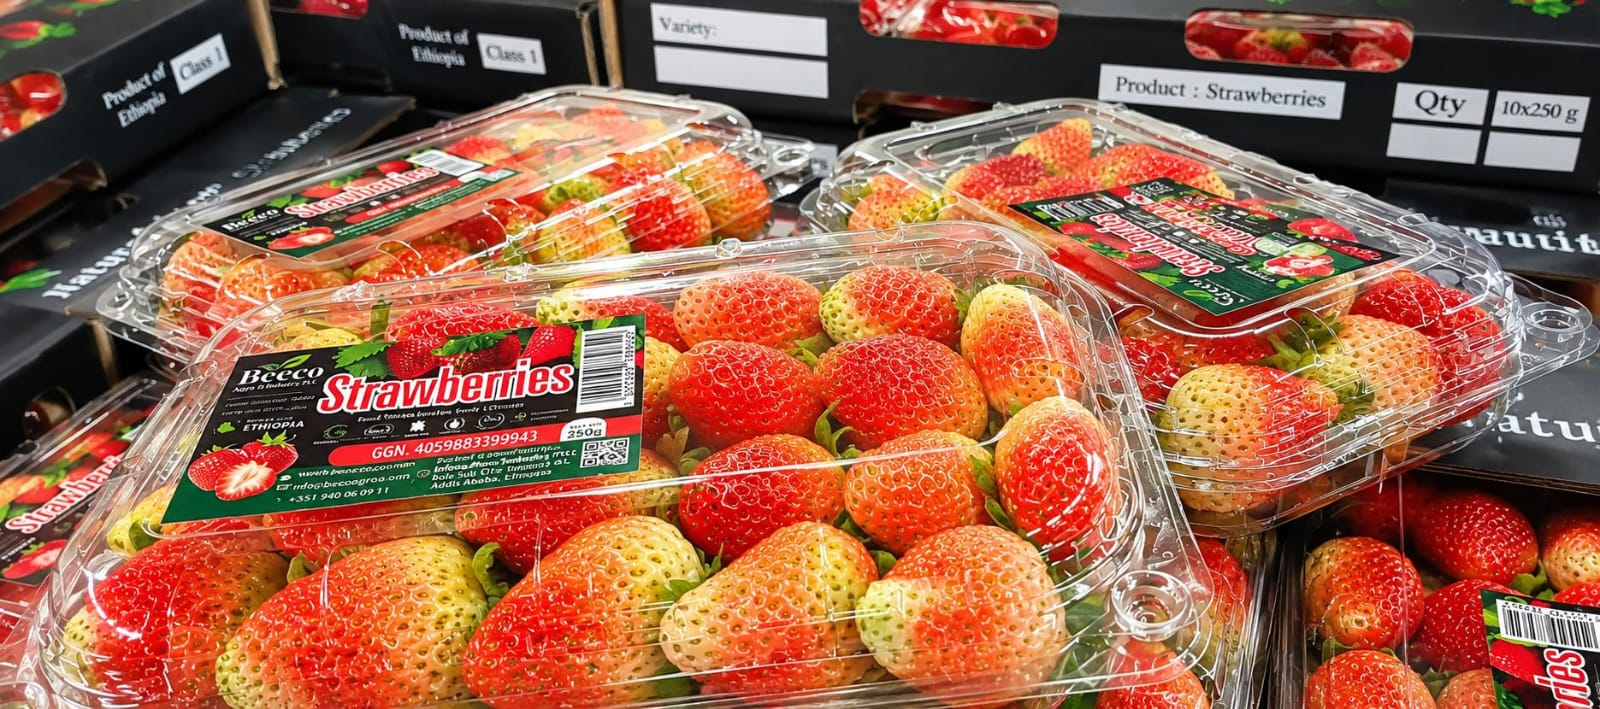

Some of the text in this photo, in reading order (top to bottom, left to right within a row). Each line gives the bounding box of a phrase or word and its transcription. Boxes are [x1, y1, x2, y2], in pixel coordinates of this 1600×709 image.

[398, 23, 469, 45] Product of
[659, 17, 717, 40] Variety:
[179, 47, 223, 81] Class 1
[411, 46, 466, 68] Ethiopia
[486, 44, 537, 64] Class 1
[102, 61, 167, 110] Product of
[1115, 76, 1185, 98] Product
[1206, 82, 1327, 108] Strawberries
[117, 91, 167, 128] Ethiopia
[1414, 89, 1467, 118] Qty
[1502, 100, 1580, 125] 10x250 g
[238, 366, 325, 386] Beeco
[316, 357, 574, 416] Strawberries
[372, 429, 539, 460] GGN. 4059883399943
[320, 490, 342, 500] 940
[343, 489, 358, 497] 06
[430, 480, 461, 490] Addis
